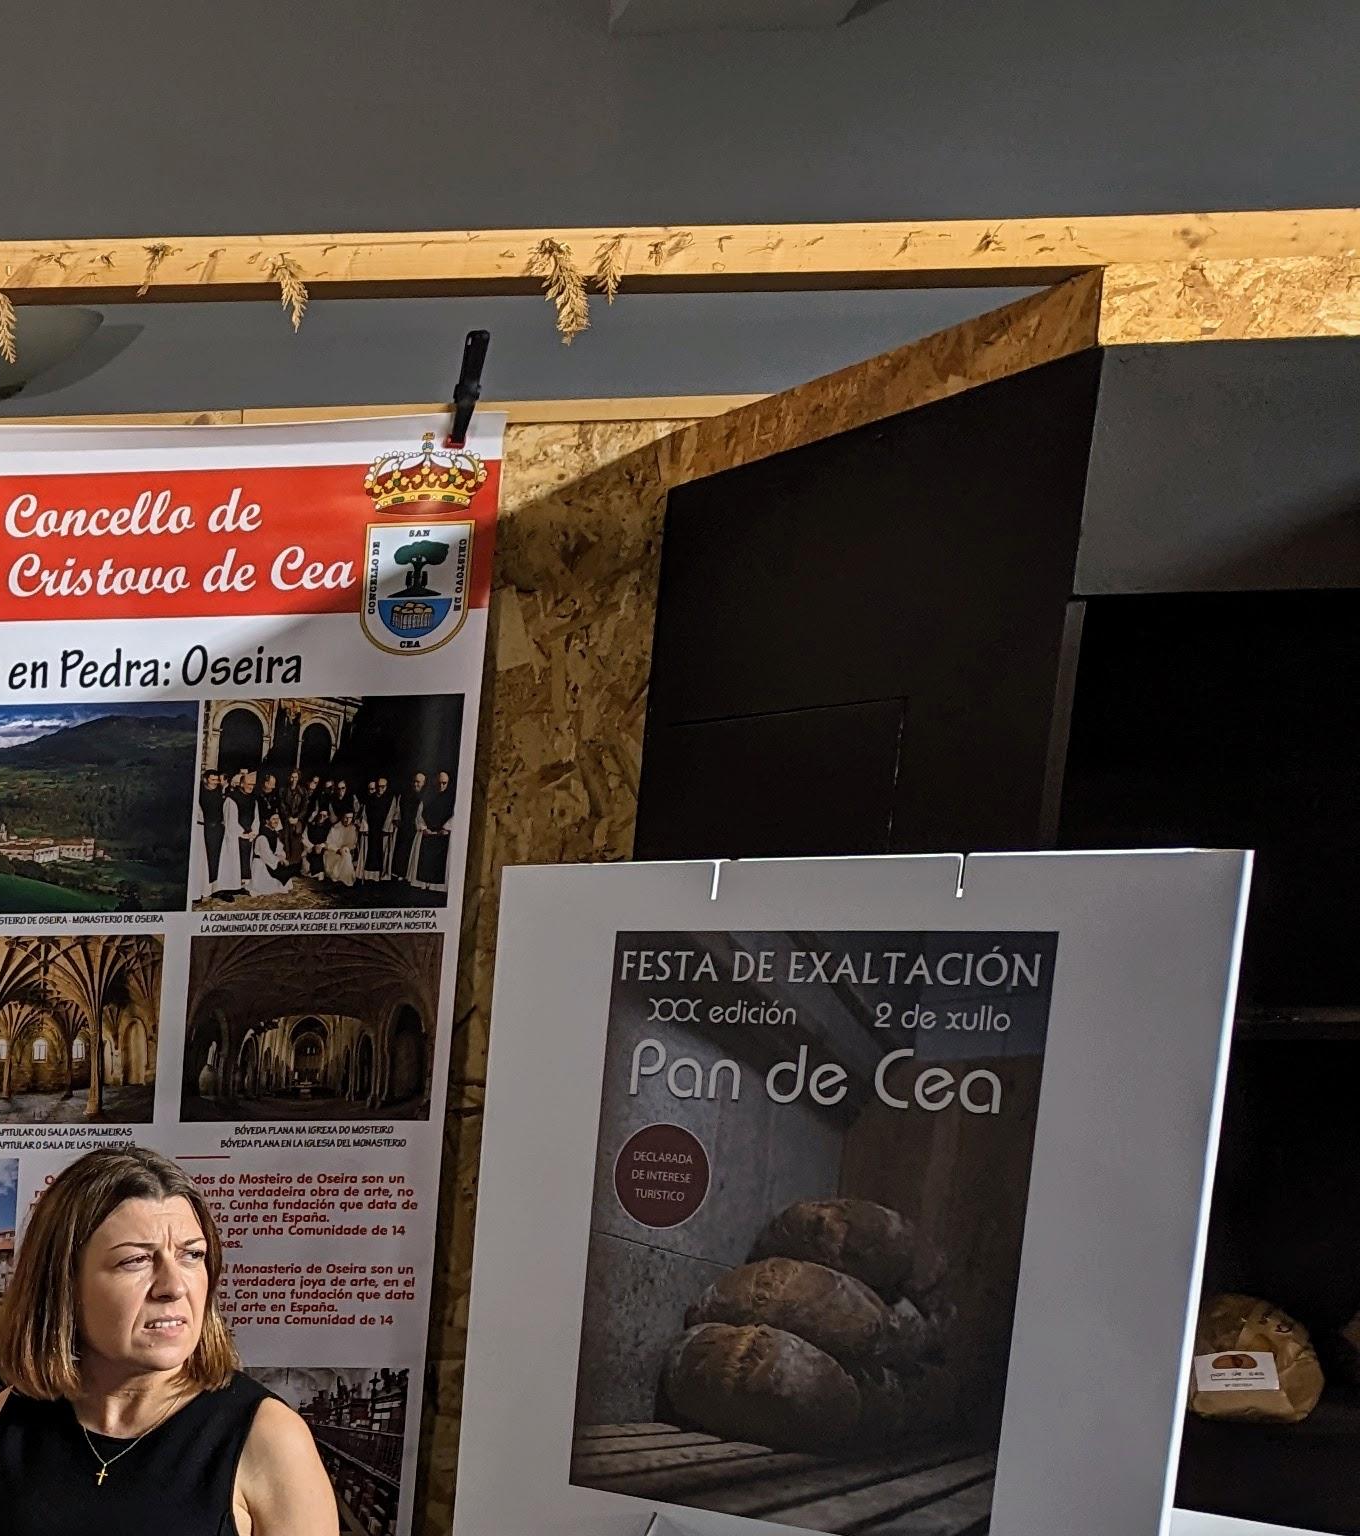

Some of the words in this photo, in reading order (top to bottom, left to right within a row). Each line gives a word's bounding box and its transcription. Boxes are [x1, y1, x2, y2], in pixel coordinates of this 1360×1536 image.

[4, 489, 195, 538] Concello
[208, 488, 261, 532] de
[409, 529, 430, 537] SAN
[372, 542, 380, 556] DE
[8, 553, 190, 598] Cristovo
[203, 548, 256, 592] de
[270, 546, 357, 591] Cea
[368, 558, 379, 615] CONCELLO
[8, 658, 48, 690] en
[61, 648, 171, 689] Pedra:
[182, 644, 302, 686] Oseira
[621, 951, 718, 982] FESTA
[732, 952, 775, 982] DE
[788, 946, 1042, 988] EXALTACIÓN
[647, 998, 701, 1021] XXX
[709, 1000, 796, 1025] edición
[874, 1002, 891, 1028] 2
[901, 1004, 936, 1030] de
[946, 1006, 1011, 1032] xullo
[629, 1039, 741, 1100] Pan
[766, 1045, 849, 1105] de
[874, 1049, 1002, 1114] Cea
[633, 1150, 693, 1164] DECLARADA
[220, 1174, 234, 1184] do
[239, 1174, 292, 1184] Mosteiro
[297, 1174, 312, 1184] de
[317, 1173, 357, 1184] Oseira
[362, 1176, 383, 1184] son
[389, 1176, 404, 1184] un
[631, 1169, 645, 1180] DE
[647, 1170, 691, 1184] INTERESE
[204, 1188, 234, 1197] unha
[239, 1187, 305, 1197] verdadeira
[310, 1187, 339, 1197] obra
[344, 1186, 359, 1196] de
[364, 1187, 392, 1198] arte,
[398, 1188, 413, 1196] no
[635, 1187, 685, 1202] TURÍSTICO
[230, 1200, 268, 1210] Cunha
[272, 1200, 334, 1210] fundación
[339, 1202, 363, 1212] que
[368, 1200, 397, 1210] data
[402, 1200, 418, 1210] de
[233, 1213, 258, 1222] arte
[262, 1214, 278, 1222] en
[282, 1212, 330, 1226] España.
[228, 1226, 248, 1238] por
[252, 1226, 283, 1235] unha
[288, 1226, 367, 1235] Comunidade
[372, 1225, 387, 1235] de
[392, 1225, 405, 1235] 14
[232, 1264, 301, 1274] Monasterio
[306, 1264, 322, 1274] de
[326, 1264, 366, 1274] Oseira
[370, 1266, 392, 1274] son
[232, 1277, 296, 1287] verdadera
[300, 1276, 326, 1290] joya
[330, 1277, 346, 1287] de
[350, 1277, 378, 1288] arte,
[383, 1279, 398, 1287] en
[404, 1276, 415, 1286] el
[235, 1290, 261, 1300] Con
[266, 1291, 285, 1300] una
[290, 1289, 352, 1300] fundación
[356, 1291, 380, 1302] que
[384, 1290, 414, 1300] data
[241, 1303, 266, 1312] arte
[270, 1304, 285, 1312] en
[290, 1302, 338, 1315] España.
[232, 1316, 252, 1327] por
[257, 1316, 280, 1325] una
[284, 1315, 355, 1325] Comunidad
[360, 1315, 375, 1325] de
[380, 1315, 393, 1325] 14
